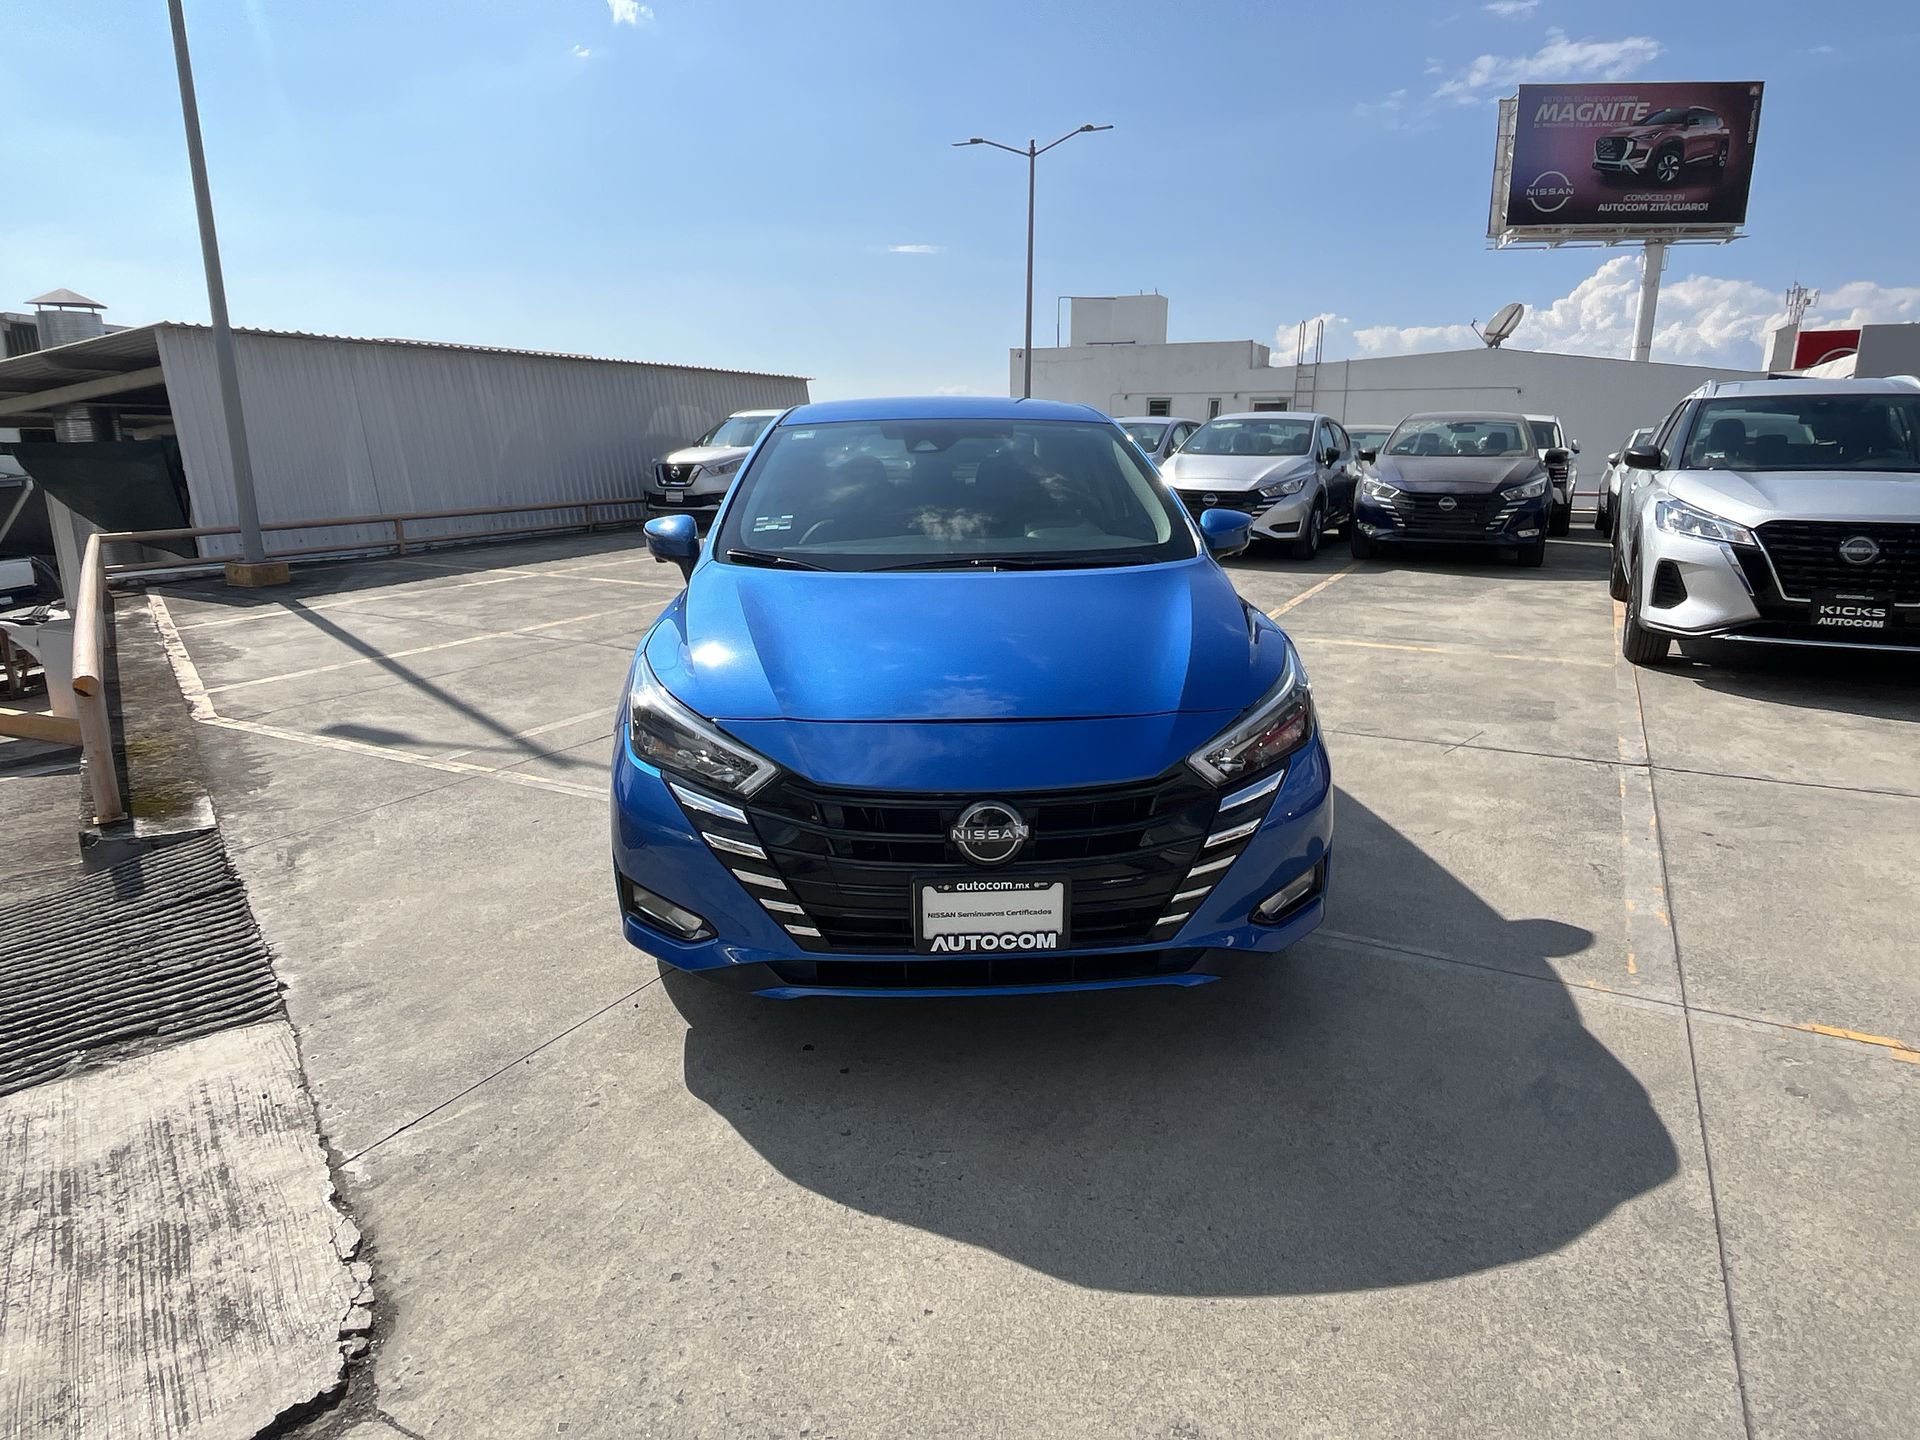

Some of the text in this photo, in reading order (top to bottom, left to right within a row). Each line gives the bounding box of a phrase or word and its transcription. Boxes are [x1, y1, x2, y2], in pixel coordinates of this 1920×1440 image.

[1534, 102, 1650, 122] MAGNITE
[1526, 187, 1575, 196] NISSAN
[1597, 203, 1648, 212] AUTOCOM
[1820, 606, 1886, 617] KICKS
[1818, 617, 1884, 628] AUTOCOM
[952, 827, 1029, 840] NISSAN
[956, 881, 1030, 891] autocom.mx
[927, 908, 1052, 919] NISSAN Seminuevos Certificados
[930, 933, 1057, 952] AUTOCOM
